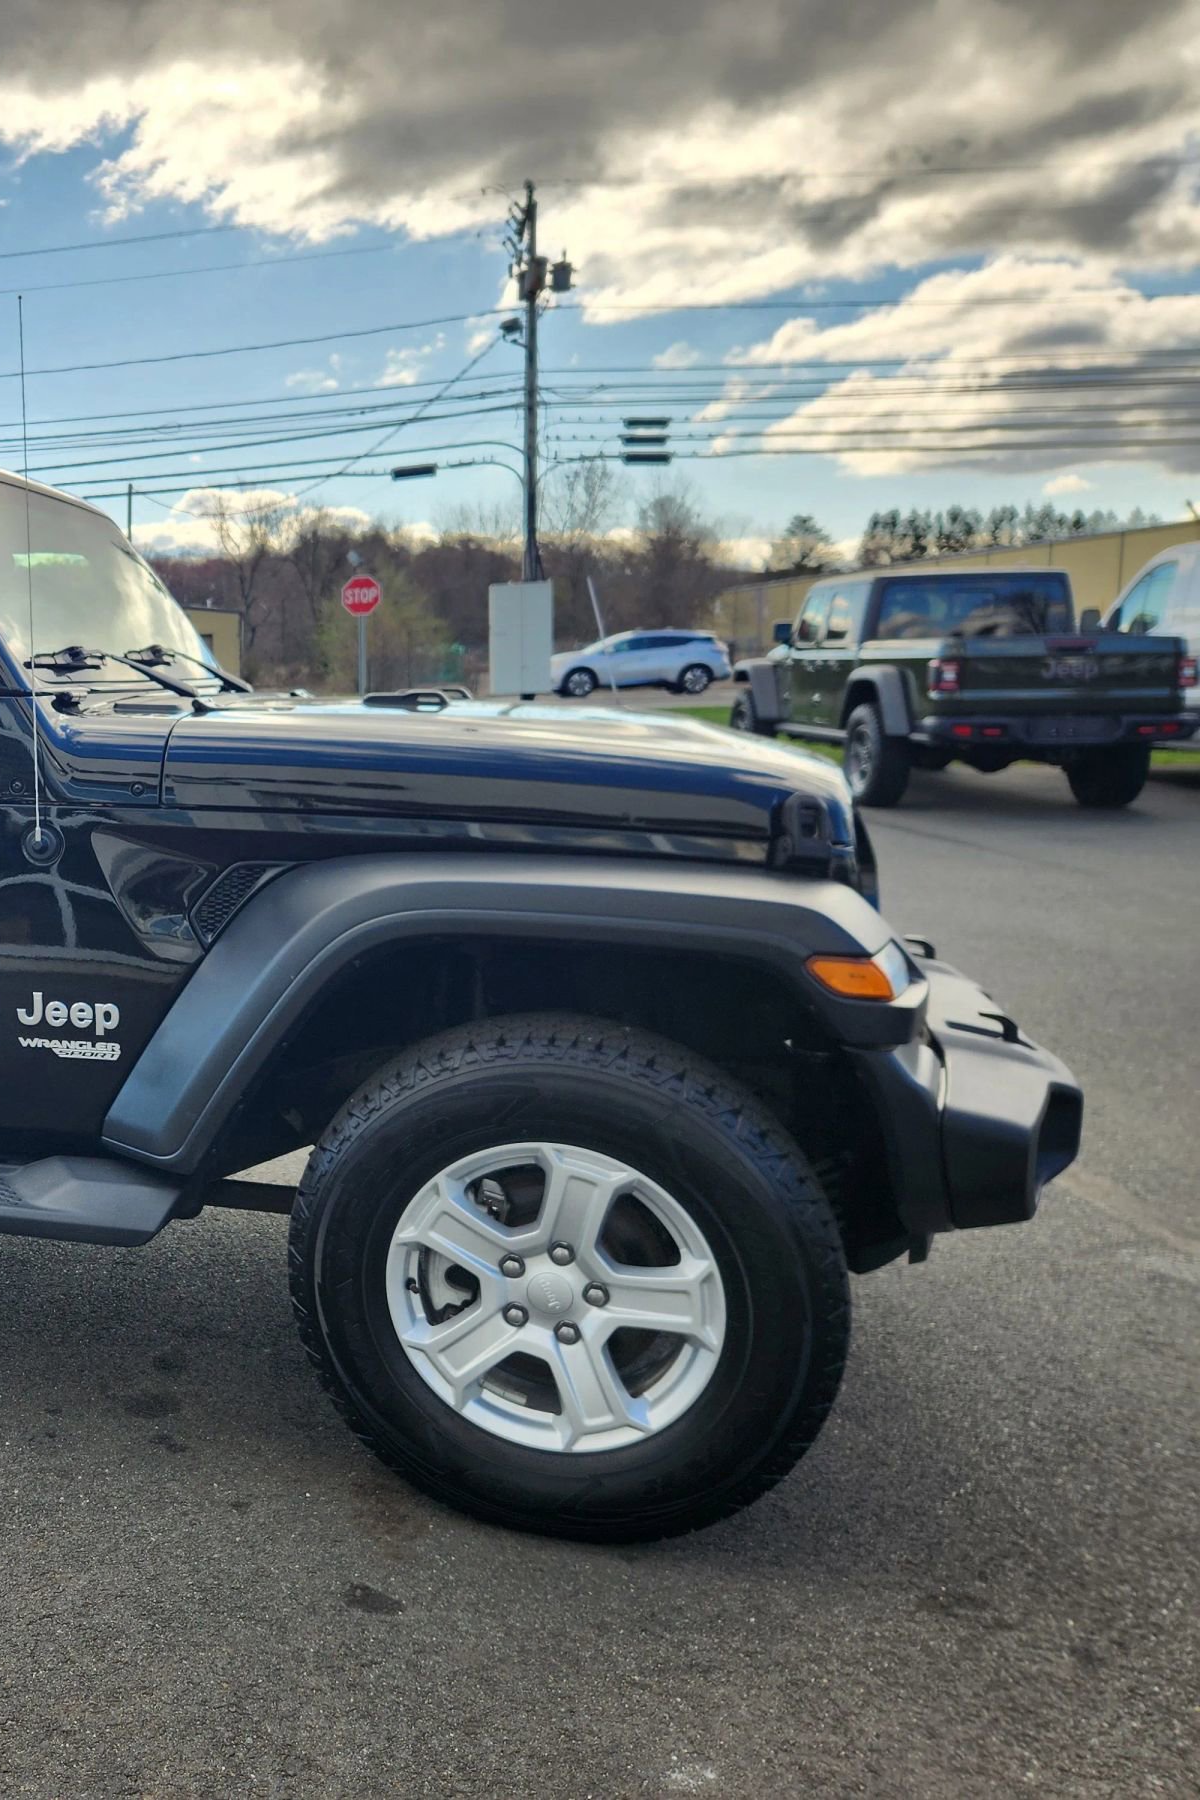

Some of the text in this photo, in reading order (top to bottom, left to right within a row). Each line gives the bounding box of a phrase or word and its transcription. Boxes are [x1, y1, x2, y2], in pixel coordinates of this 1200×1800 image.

[344, 587, 377, 604] STOP
[1041, 657, 1098, 681] Jeep
[16, 991, 120, 1036] Jeep
[18, 1036, 121, 1052] WRANGLER
[54, 1049, 119, 1060] SPORT
